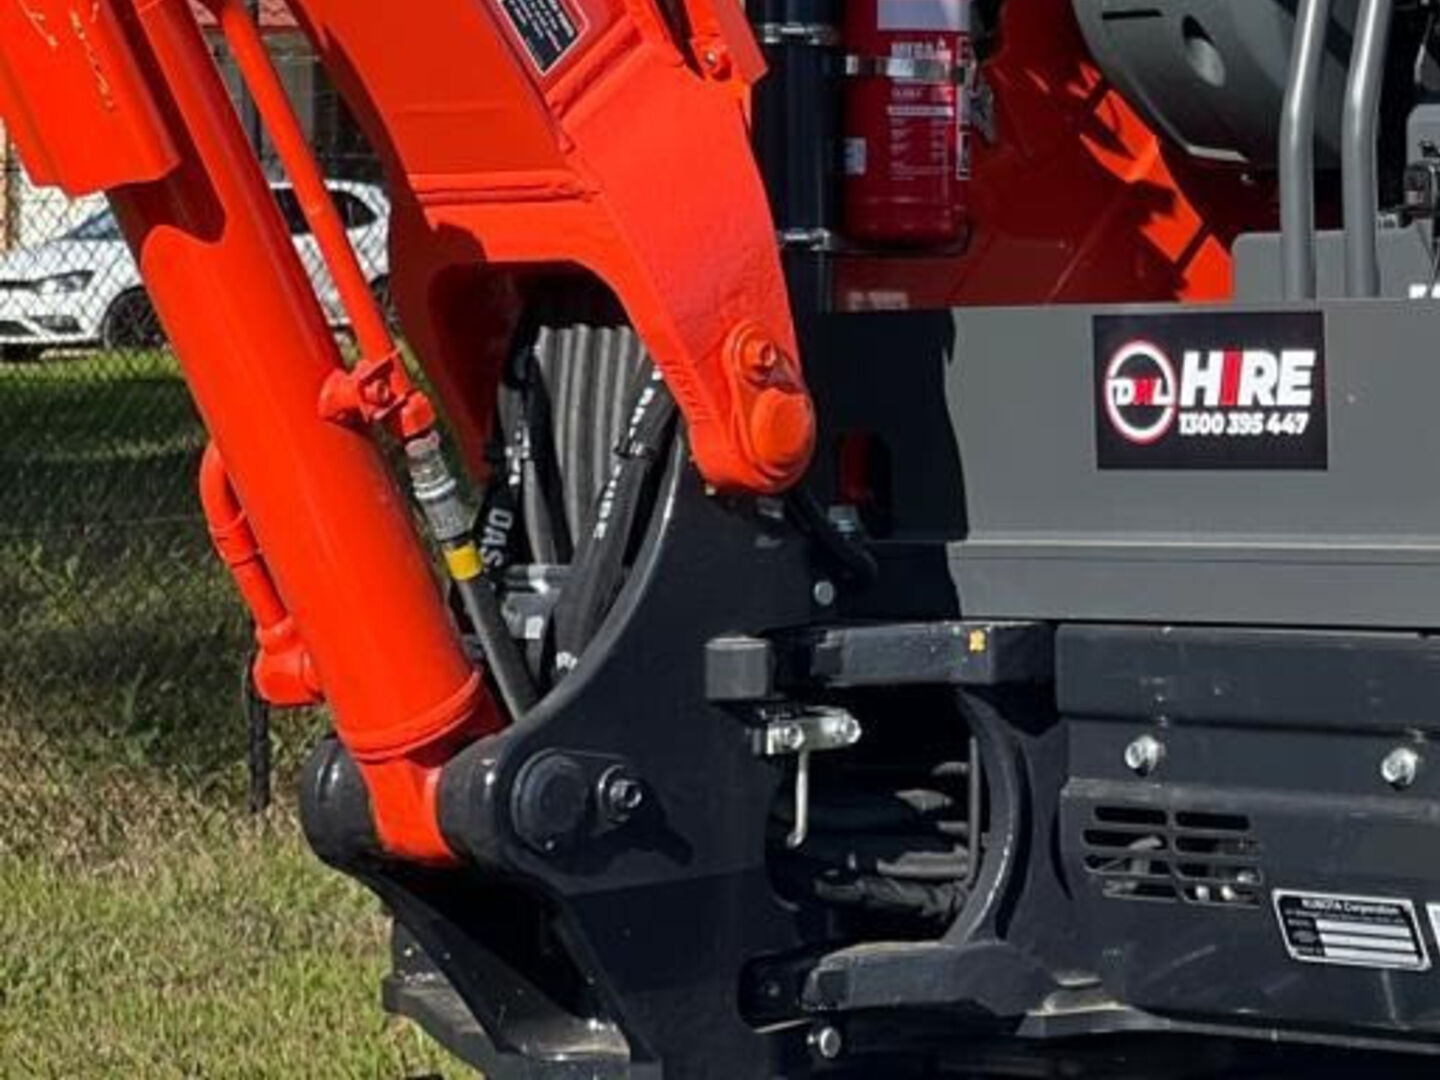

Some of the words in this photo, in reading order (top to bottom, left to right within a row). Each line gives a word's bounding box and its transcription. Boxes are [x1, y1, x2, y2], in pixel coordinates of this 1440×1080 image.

[1180, 349, 1316, 406] HIRE
[1178, 412, 1223, 435] 1300
[1266, 412, 1310, 435] 447
